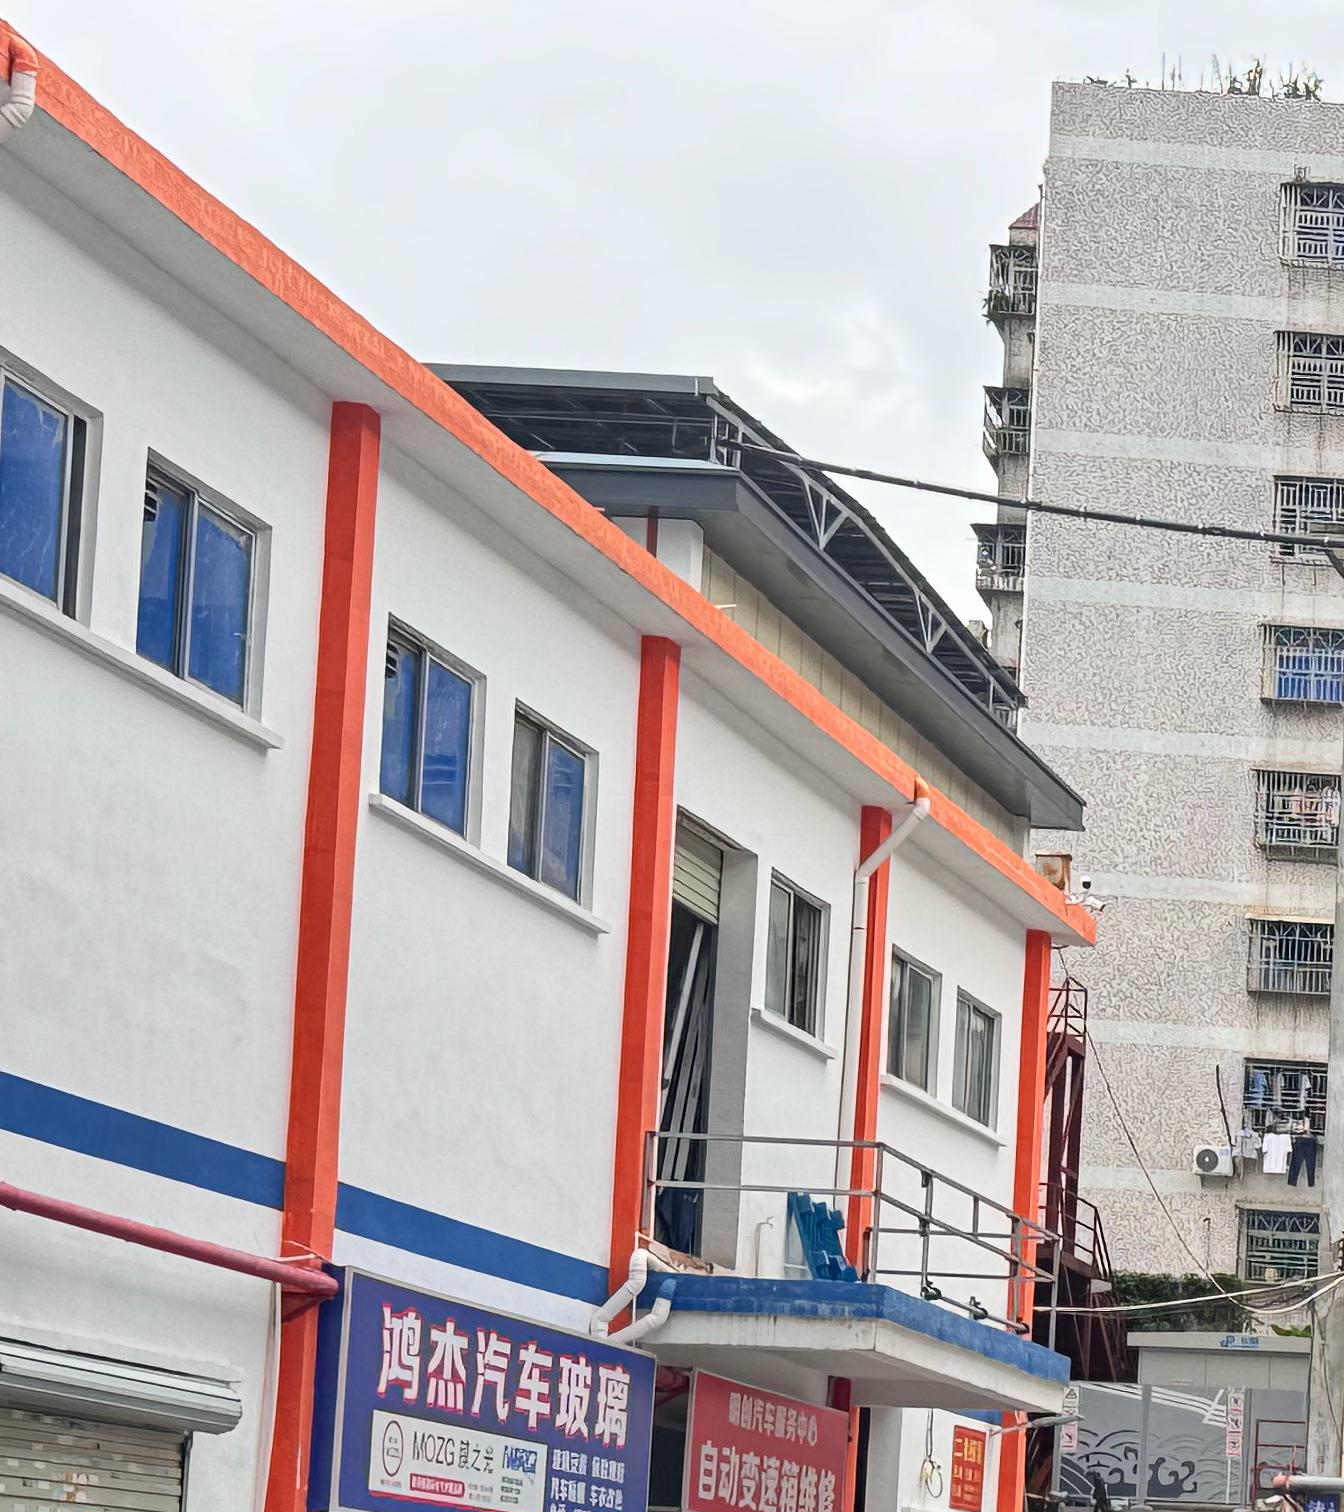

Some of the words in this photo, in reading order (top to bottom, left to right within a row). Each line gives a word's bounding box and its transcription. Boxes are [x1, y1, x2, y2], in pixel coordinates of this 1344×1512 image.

[376, 1301, 631, 1449] 鸿杰汽车玻璃
[412, 1430, 455, 1466] MOZG
